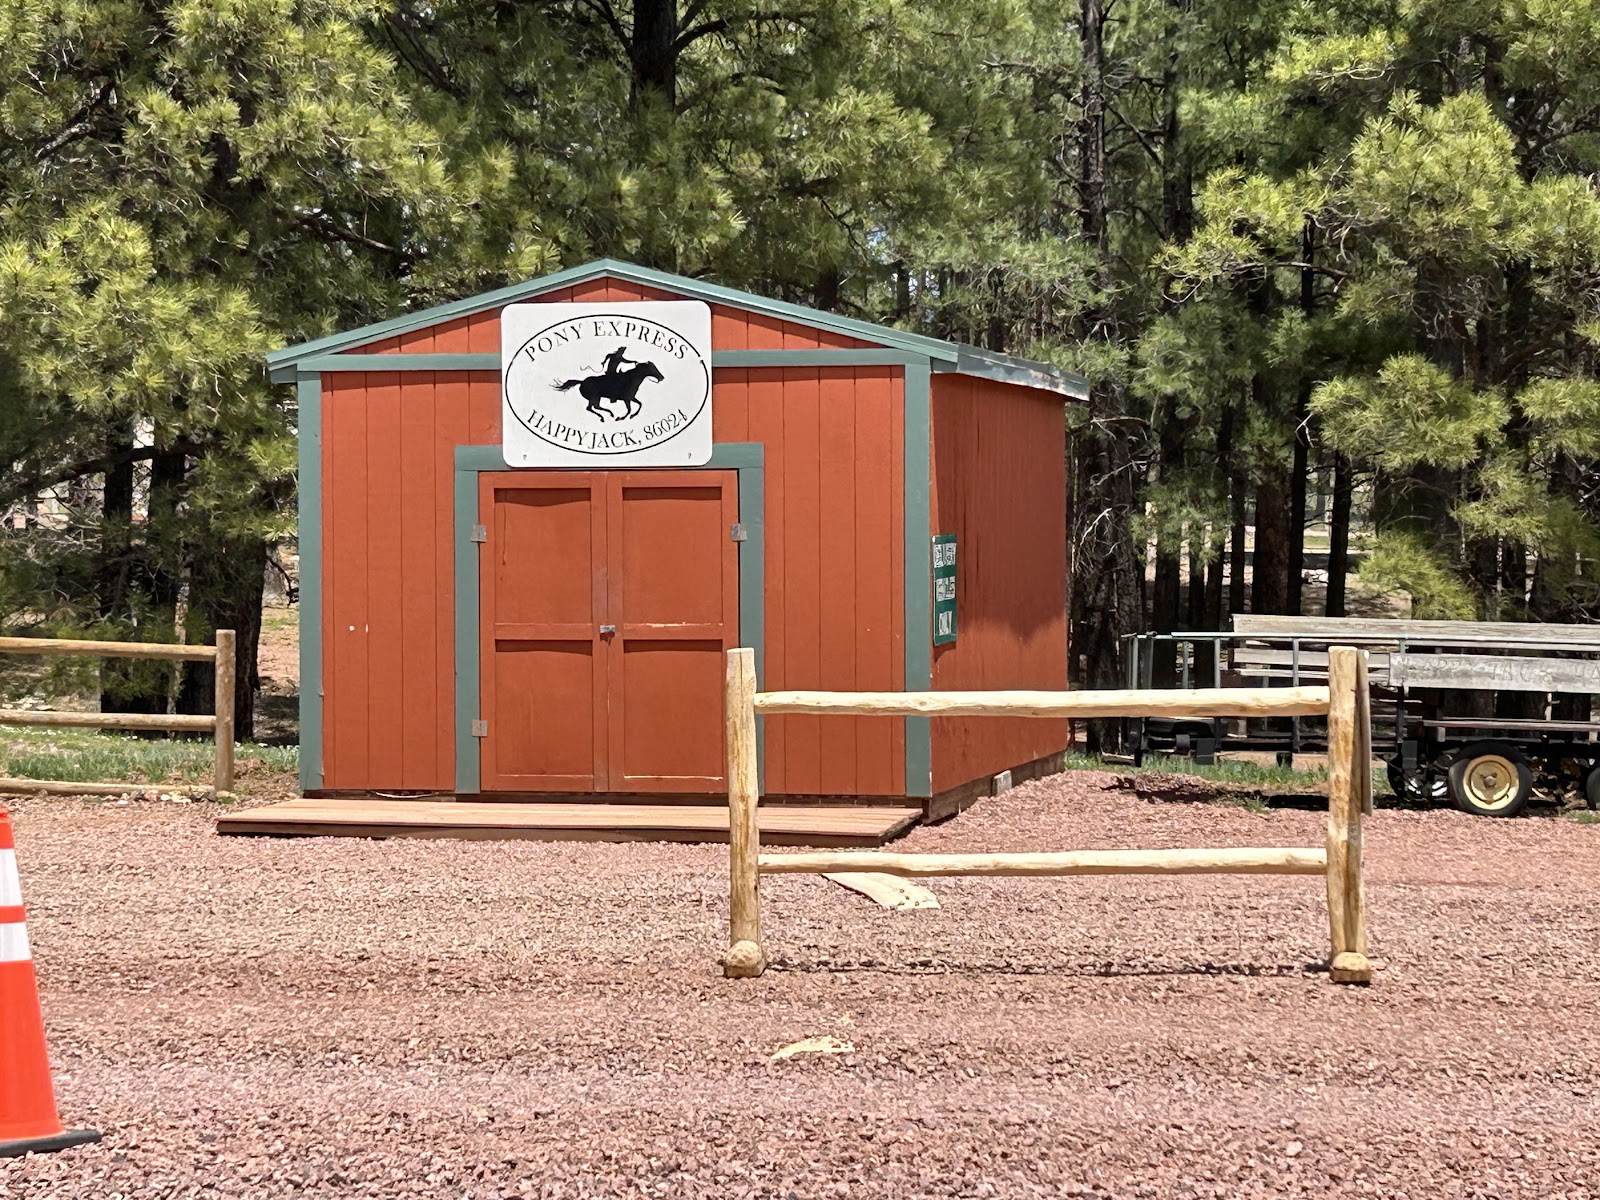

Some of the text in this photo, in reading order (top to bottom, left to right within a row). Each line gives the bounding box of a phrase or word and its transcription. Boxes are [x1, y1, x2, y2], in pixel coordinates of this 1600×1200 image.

[524, 320, 689, 362] PONY EXPRESS
[527, 408, 688, 449] HAPPY JACK, 86024
